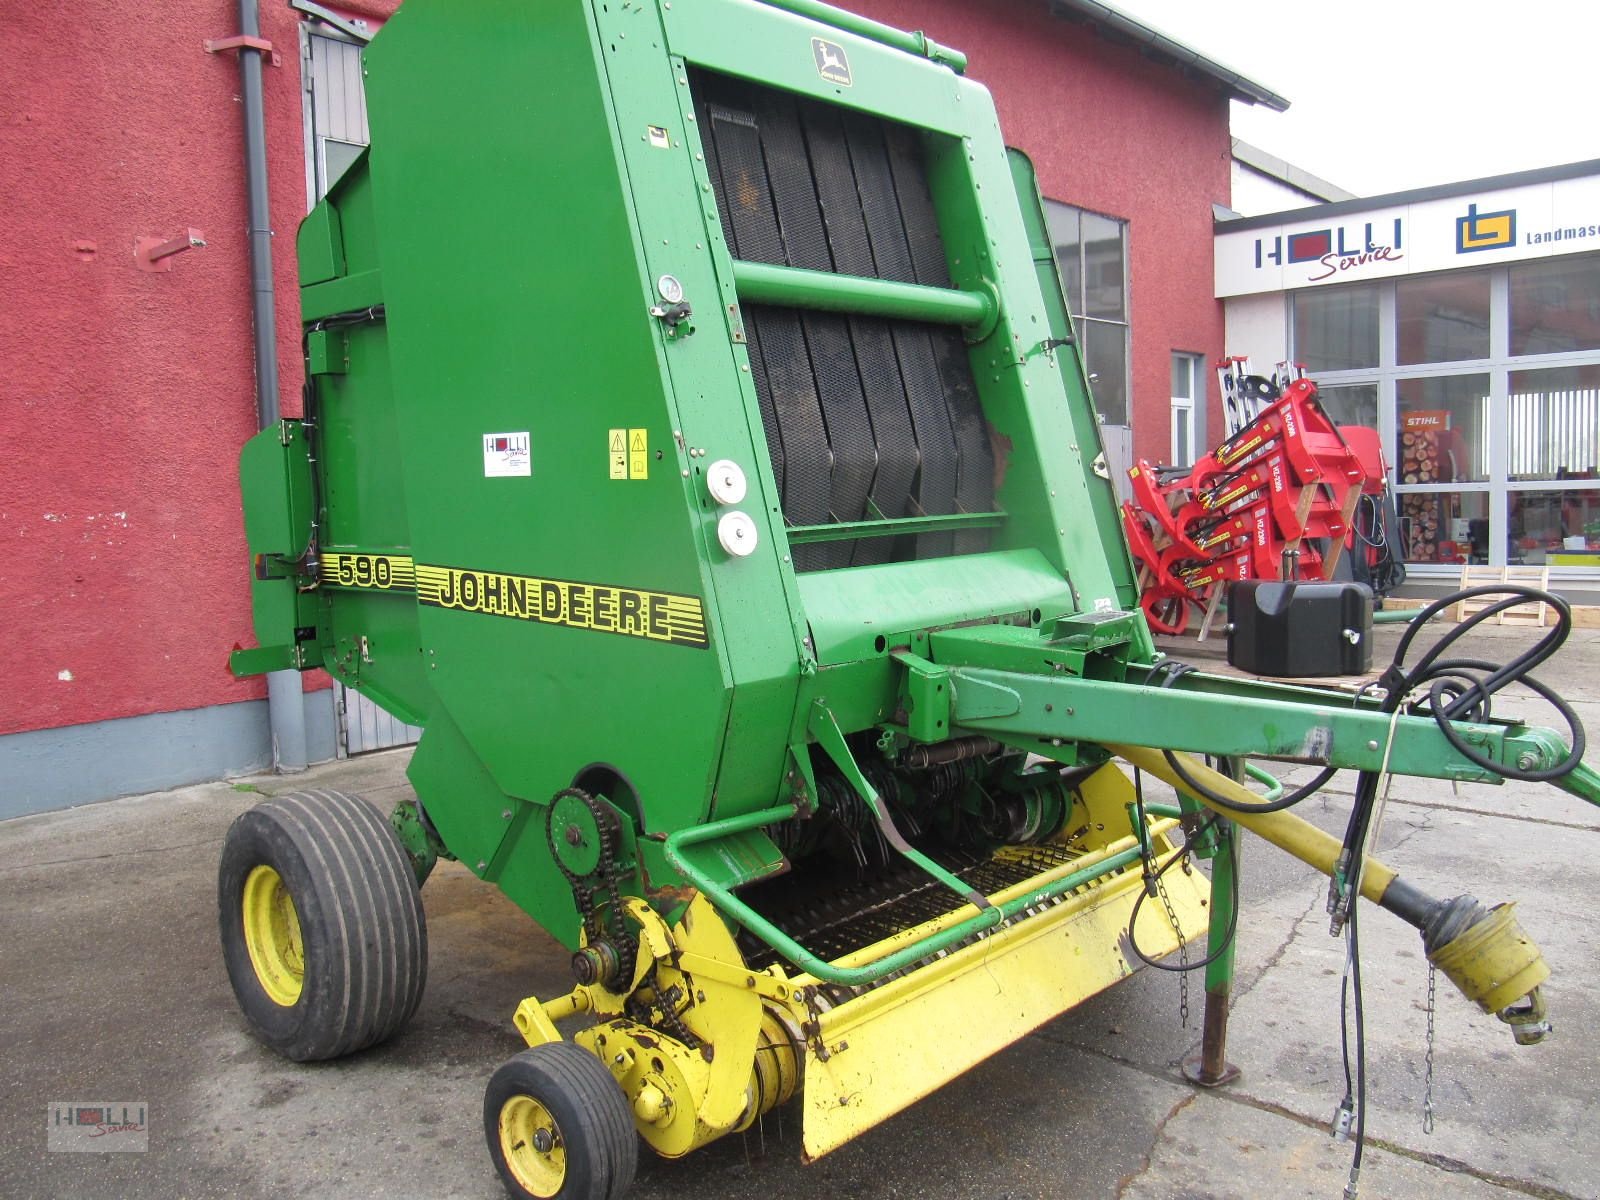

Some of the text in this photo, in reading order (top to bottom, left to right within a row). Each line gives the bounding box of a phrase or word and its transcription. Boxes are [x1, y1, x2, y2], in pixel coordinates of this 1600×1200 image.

[1255, 217, 1402, 269] HOLLI
[1526, 224, 1600, 245] Landmas
[1308, 246, 1404, 281] Service
[1407, 416, 1440, 426] STIHL
[486, 436, 527, 453] HOLLI
[338, 554, 392, 589] 590
[439, 570, 670, 636] JOHN DEERE
